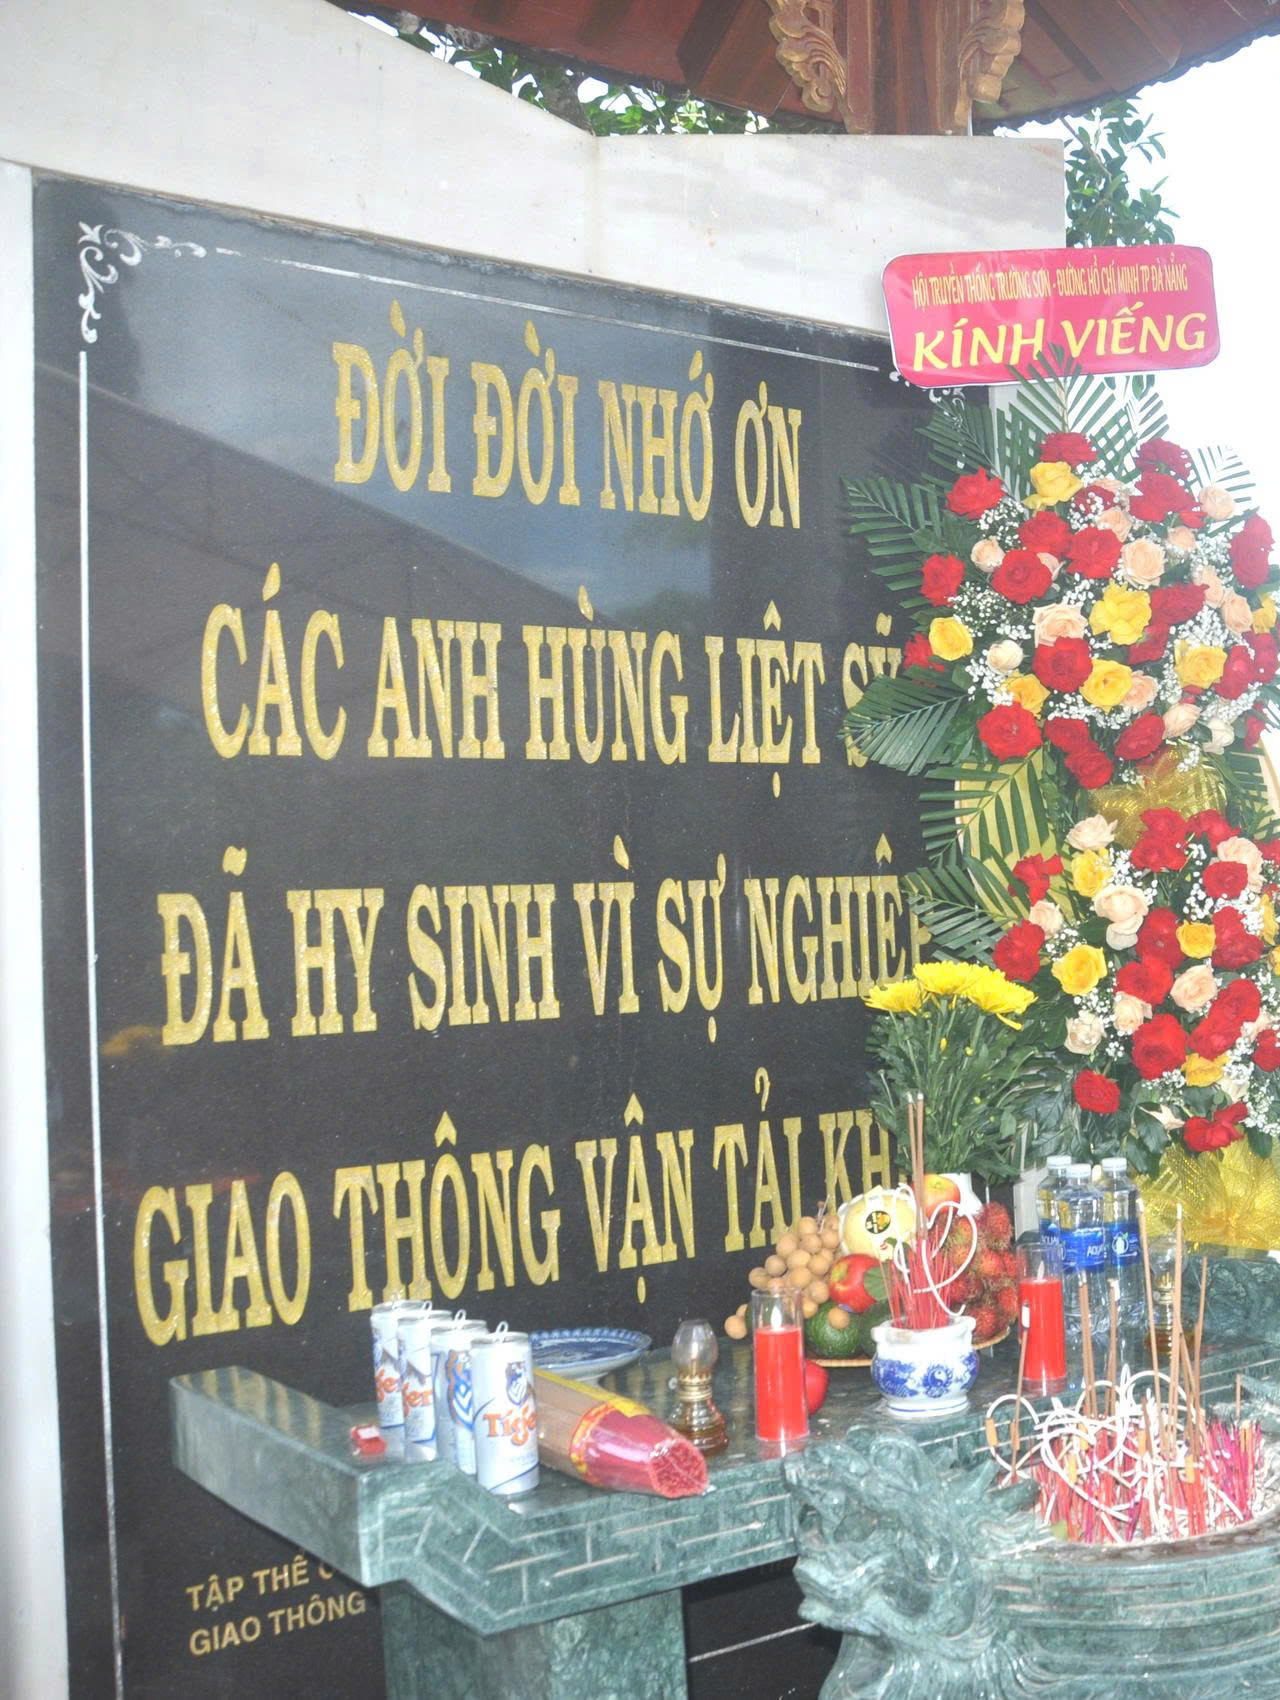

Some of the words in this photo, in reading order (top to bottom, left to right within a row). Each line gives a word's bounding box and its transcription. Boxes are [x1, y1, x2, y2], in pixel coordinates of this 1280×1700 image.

[913, 317, 1046, 372] KÍNH
[1060, 301, 1208, 359] VIẾNG
[964, 263, 996, 303] THỐNG
[996, 264, 1031, 301] TRƯỜNG
[1101, 260, 1117, 296] CHÍ
[1117, 265, 1139, 296] MINH
[1139, 265, 1151, 294] TP
[1151, 258, 1165, 292] ĐÀ
[332, 300, 452, 493] ĐỜI
[471, 320, 581, 506] ĐỜI
[599, 350, 715, 521] NHỚ
[735, 381, 802, 529] ƠN
[201, 562, 347, 760] CÁC
[367, 616, 506, 760] ANH
[523, 585, 689, 765] HÙNG
[705, 600, 827, 798] LIỆT
[157, 845, 270, 1046] ĐÃ
[286, 887, 385, 1036] HY
[407, 883, 560, 1031] SINH
[573, 834, 640, 1016] VÌ
[656, 853, 728, 1043] SỰ
[133, 1170, 312, 1346] GIAO
[333, 1110, 561, 1312] THÔNG
[575, 1093, 695, 1303] VẬN
[712, 1067, 803, 1253] TẢI
[186, 1574, 244, 1612] TẬP
[189, 1616, 262, 1656] GIAO
[267, 1590, 367, 1635] THÔNG
